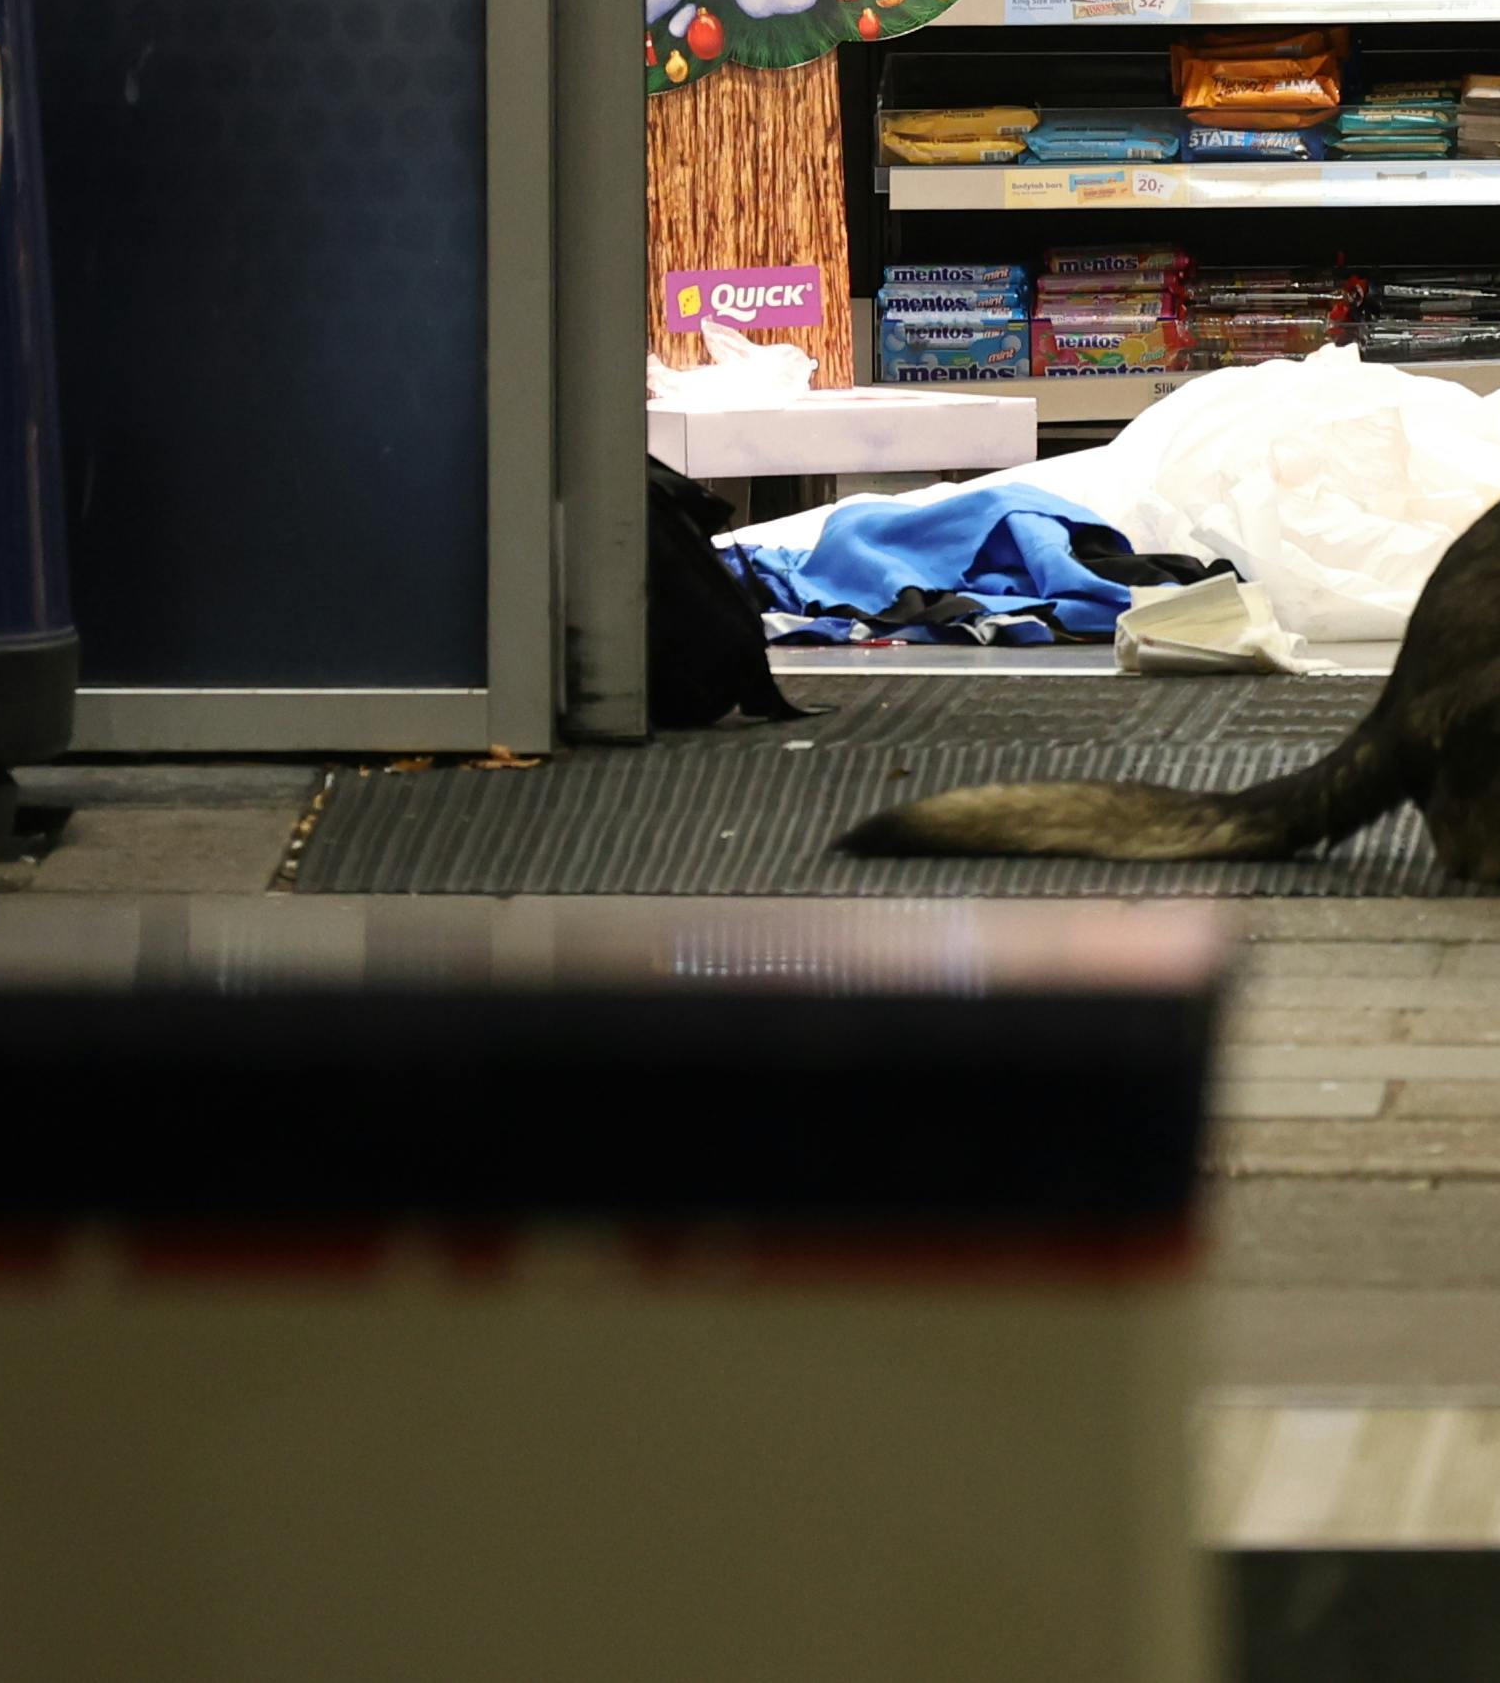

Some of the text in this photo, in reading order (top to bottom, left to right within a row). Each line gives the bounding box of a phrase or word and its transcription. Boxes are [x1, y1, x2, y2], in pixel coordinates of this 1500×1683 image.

[1188, 129, 1247, 149] STATE
[1138, 178, 1165, 193] 20,-
[1058, 255, 1140, 273] mentos
[893, 267, 1011, 283] mentos mint
[710, 283, 806, 323] QUICK
[886, 294, 1006, 313] mentos mint
[987, 348, 1017, 364] mint
[897, 365, 1017, 381] mentos
[1154, 381, 1178, 395] Slik
